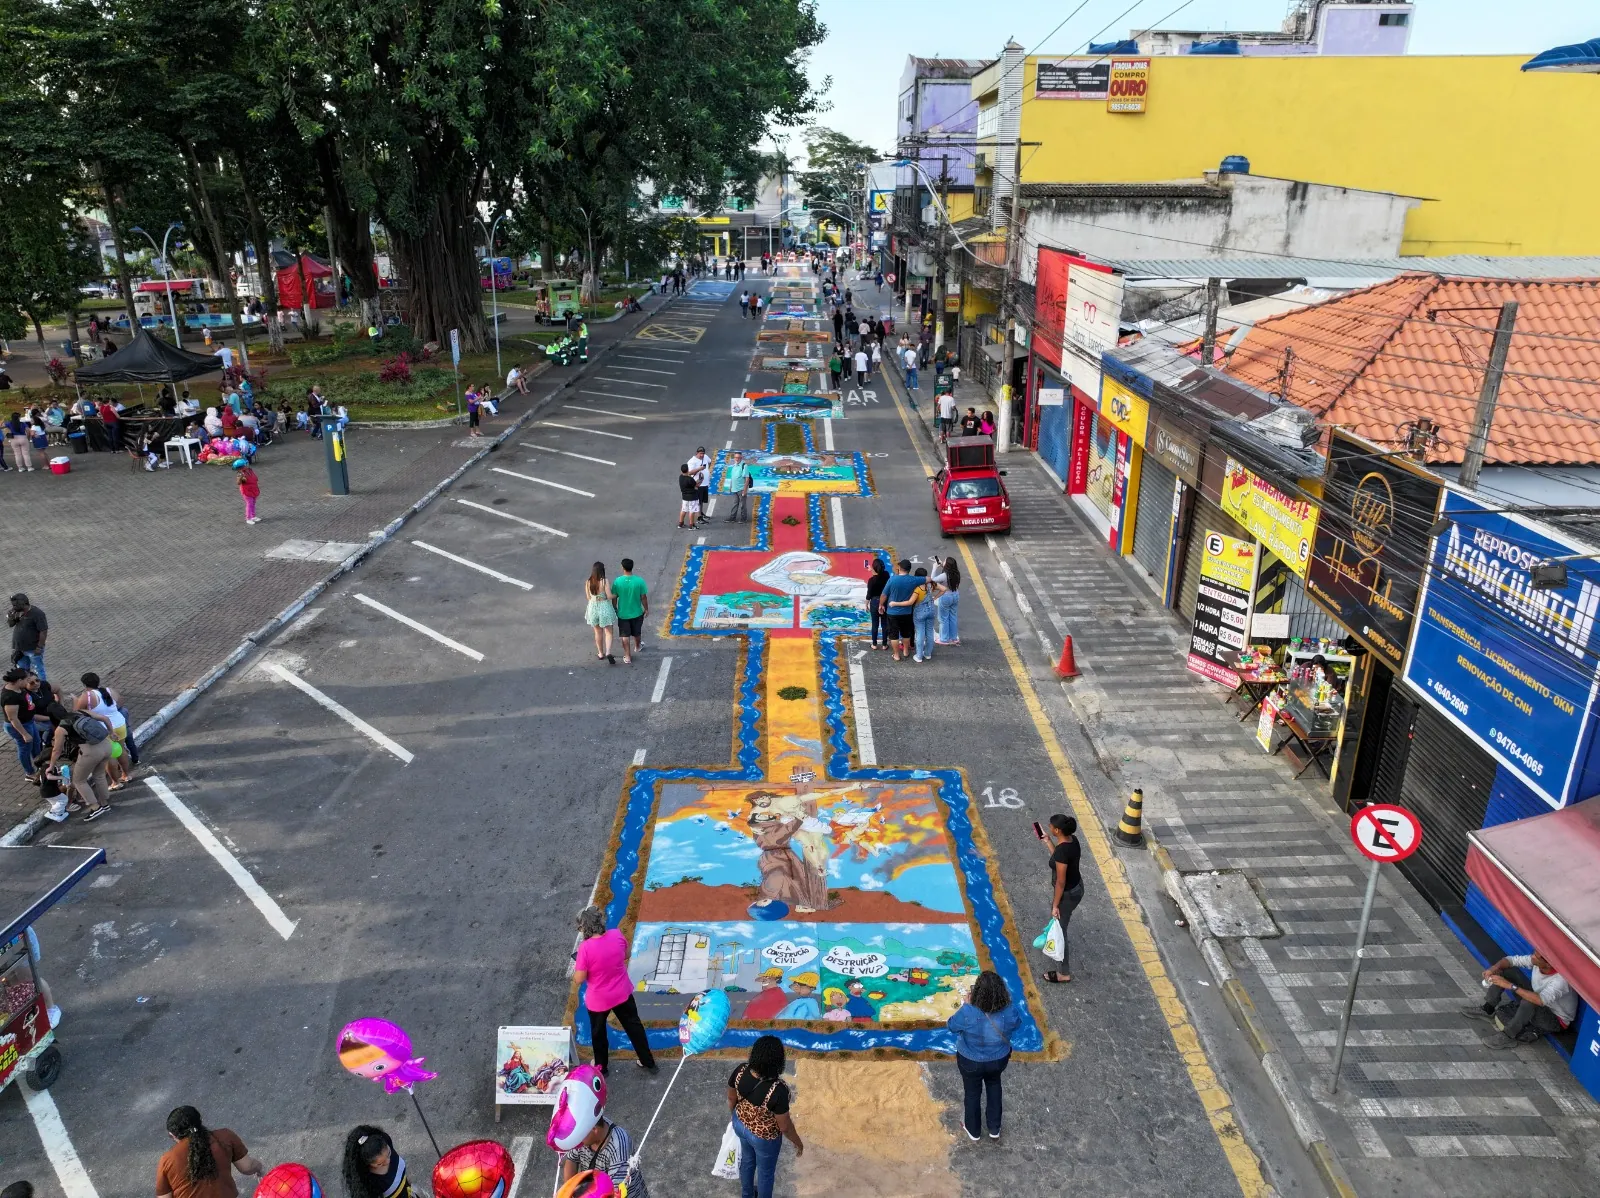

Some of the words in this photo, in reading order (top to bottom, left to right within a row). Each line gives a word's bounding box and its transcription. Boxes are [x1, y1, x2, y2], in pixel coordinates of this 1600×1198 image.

[1110, 79, 1146, 96] OURO
[1253, 493, 1303, 537] ESTACIONAMENTO
[1209, 537, 1220, 552] E
[1249, 516, 1267, 540] LAVA
[1268, 533, 1297, 565] RÁPIDO
[1202, 586, 1237, 605] ENTRADA
[1197, 602, 1205, 612] 1/2
[1205, 606, 1220, 617] HORA
[1222, 611, 1230, 620] R$
[1230, 614, 1244, 625] 5,00
[1199, 622, 1218, 636] HORA
[1219, 630, 1227, 639] R$
[1428, 606, 1481, 651] TRANSFERÊNCIA
[1193, 636, 1215, 649] DEMAIS
[1193, 643, 1214, 656] HORAS
[1189, 655, 1206, 668] TEMOS
[1457, 654, 1502, 694] RENOVAÇÃO
[1502, 689, 1514, 703] DE
[1514, 696, 1533, 716] CNH
[1433, 681, 1469, 716] 4640-2606
[1496, 731, 1544, 777] 94764-4065
[981, 786, 1026, 810] 18
[1372, 817, 1399, 849] E
[858, 964, 883, 974] VIU?
